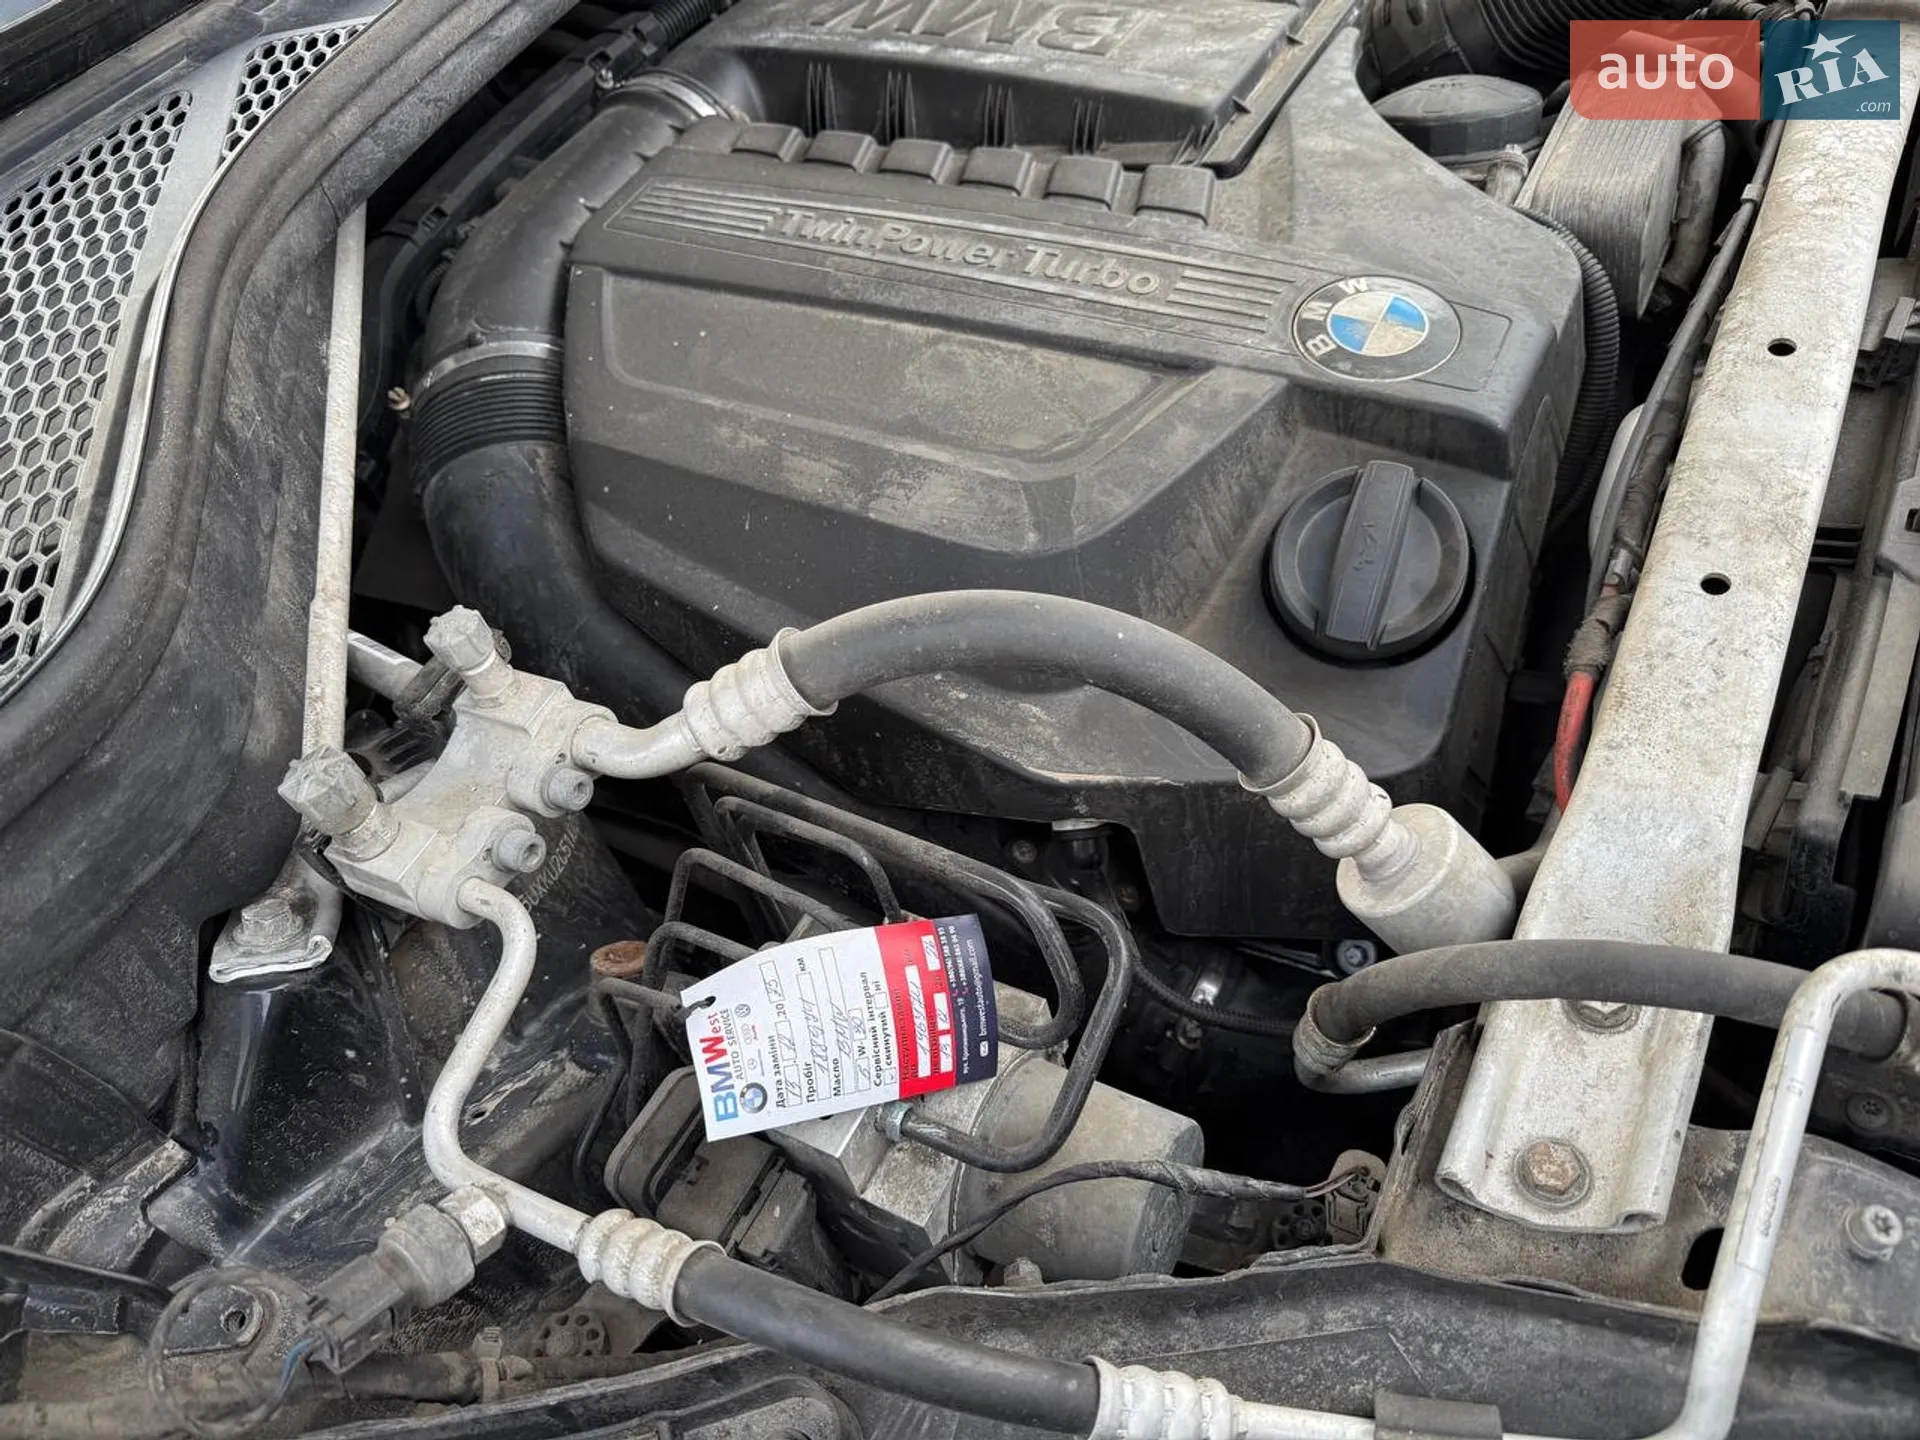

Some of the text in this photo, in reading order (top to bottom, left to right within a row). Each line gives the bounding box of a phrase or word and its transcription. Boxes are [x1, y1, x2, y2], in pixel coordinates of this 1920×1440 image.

[777, 207, 1164, 295] TwinPower Turbo
[1301, 277, 1370, 358] BMW
[796, 957, 808, 972] км
[719, 1008, 745, 1080] AUTO SERVICE
[860, 971, 882, 1088] Сервісний інтервал
[878, 1011, 893, 1067] скинутий
[699, 1012, 739, 1122] BMWest
[768, 1034, 787, 1108] Дата заміни
[802, 1061, 816, 1103] Пробіг
[831, 1057, 842, 1097] Масло
